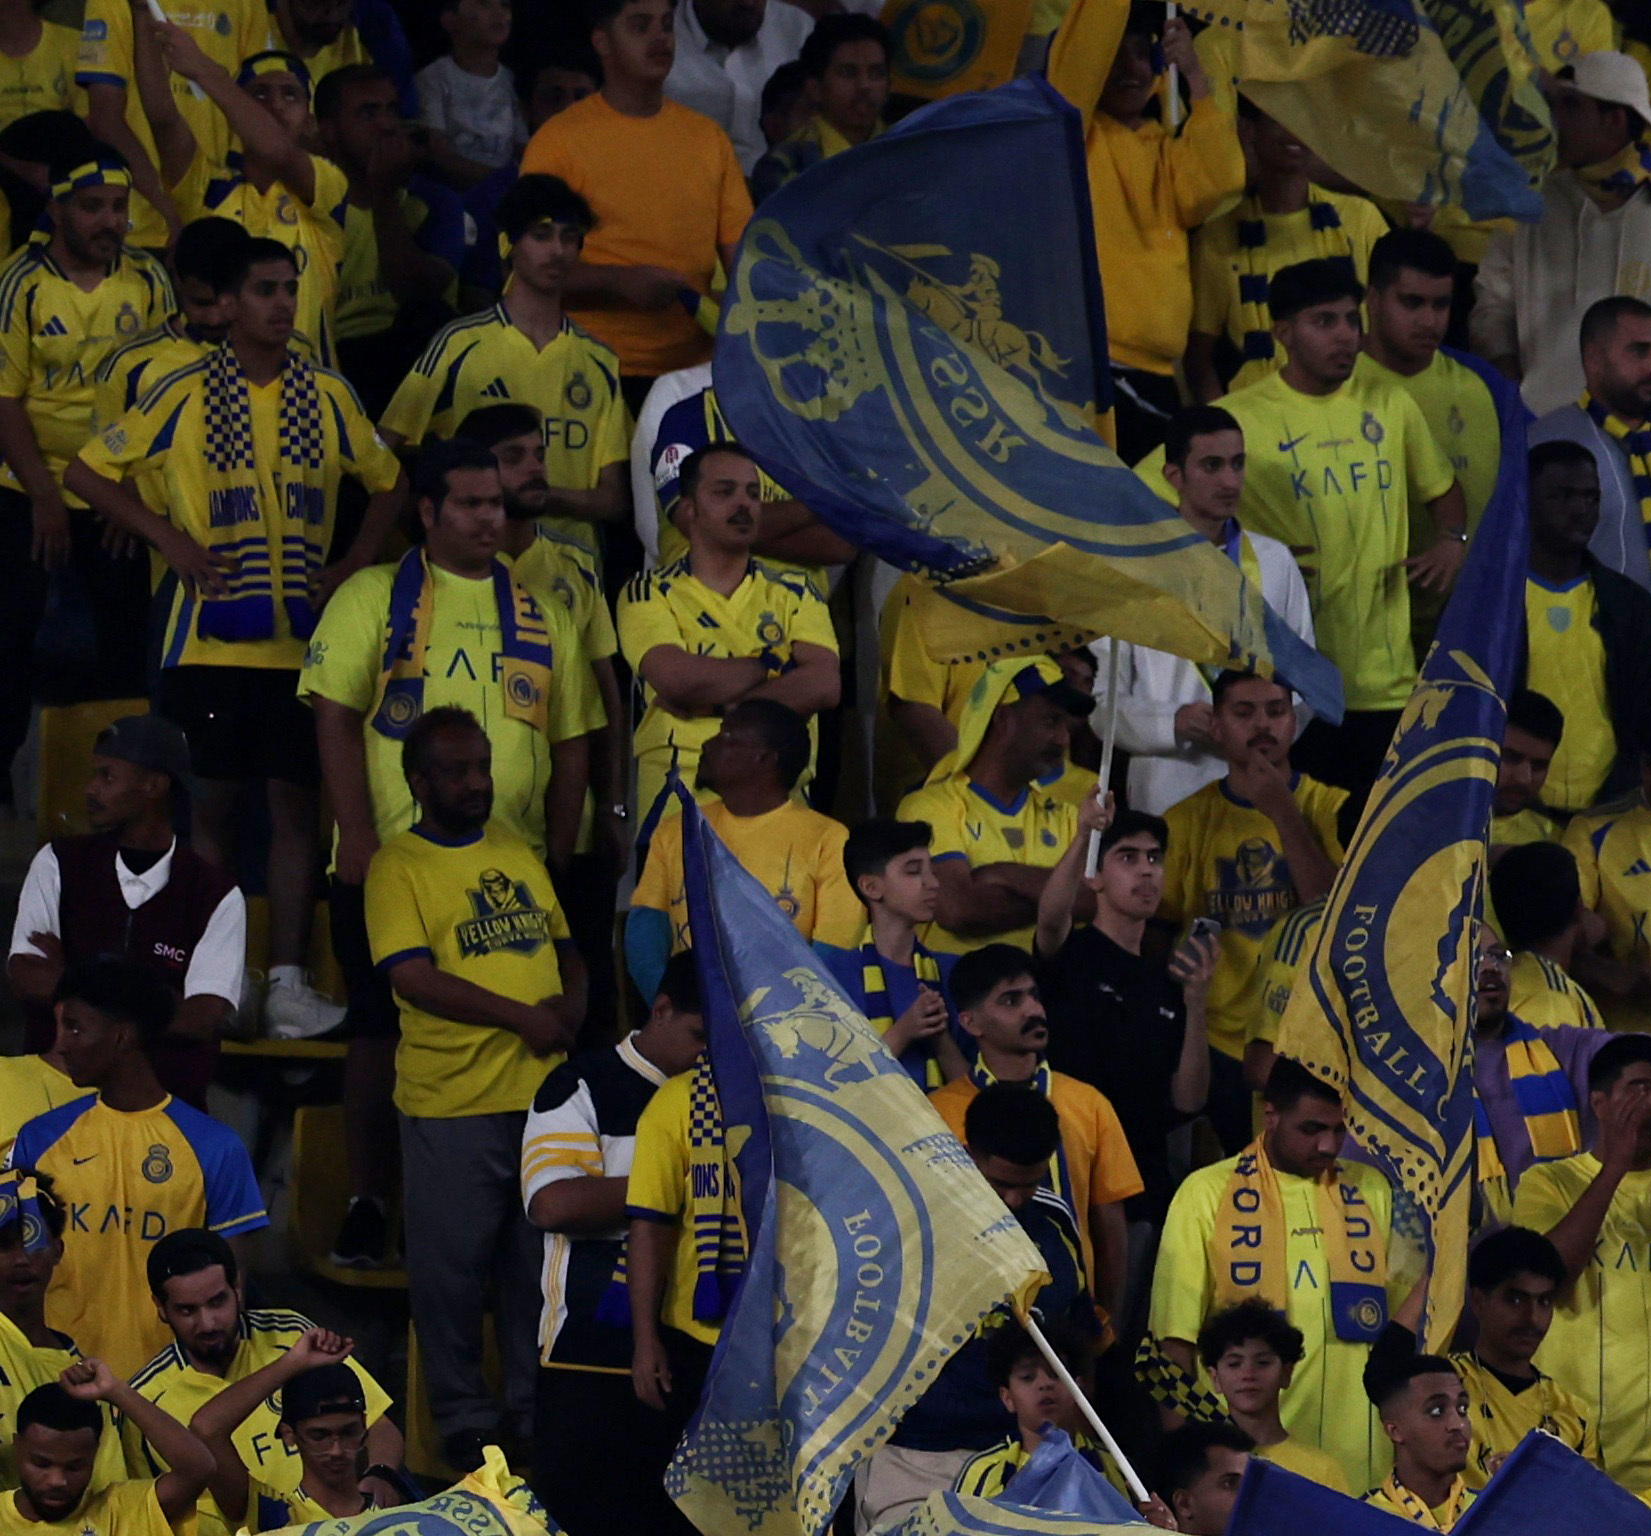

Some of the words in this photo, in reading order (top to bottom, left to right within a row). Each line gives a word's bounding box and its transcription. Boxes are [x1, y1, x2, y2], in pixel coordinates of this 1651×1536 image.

[542, 417, 589, 450] FD
[1291, 461, 1393, 501] KAFD
[153, 941, 187, 963] SMC
[1339, 902, 1428, 1097] FOOTBALL
[1344, 1178, 1376, 1276] CUR
